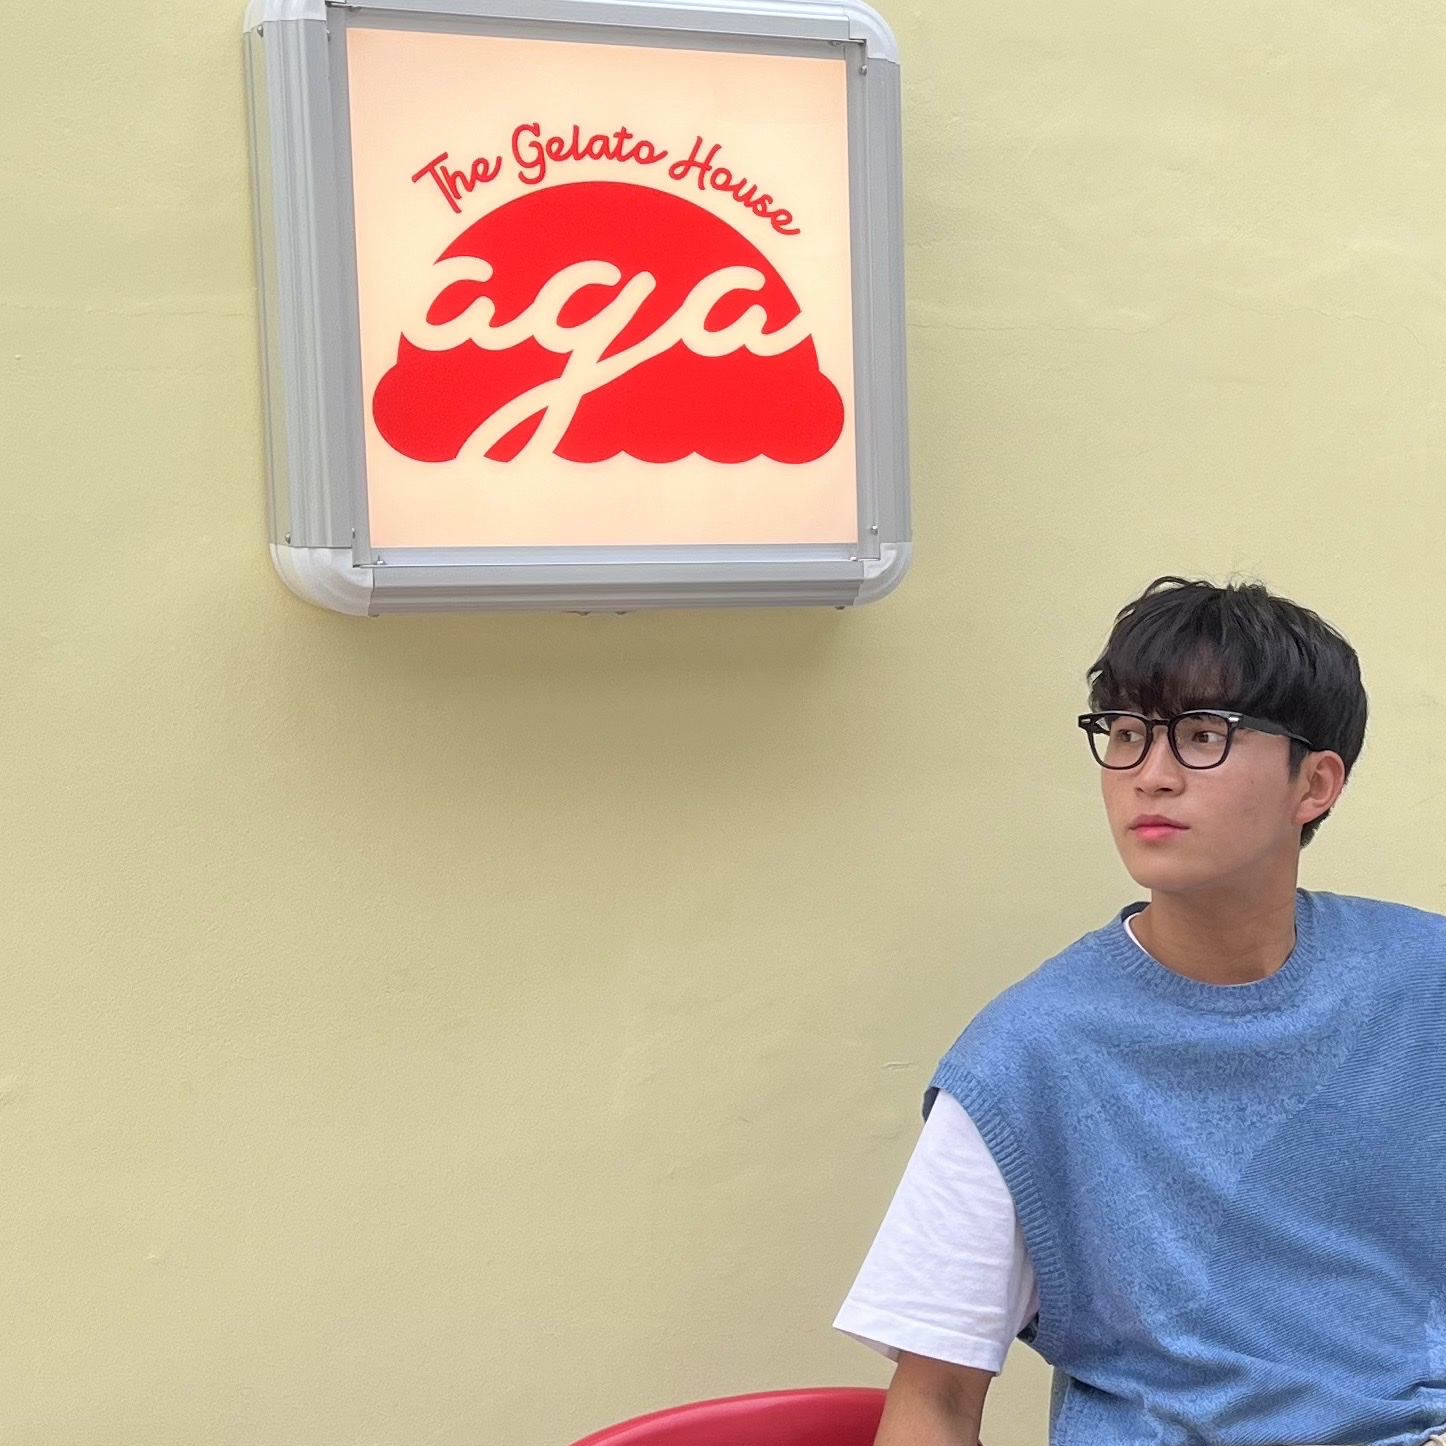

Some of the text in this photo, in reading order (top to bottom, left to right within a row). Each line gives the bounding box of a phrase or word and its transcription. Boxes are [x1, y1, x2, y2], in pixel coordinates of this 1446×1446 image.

[412, 123, 800, 236] The Gelato House
